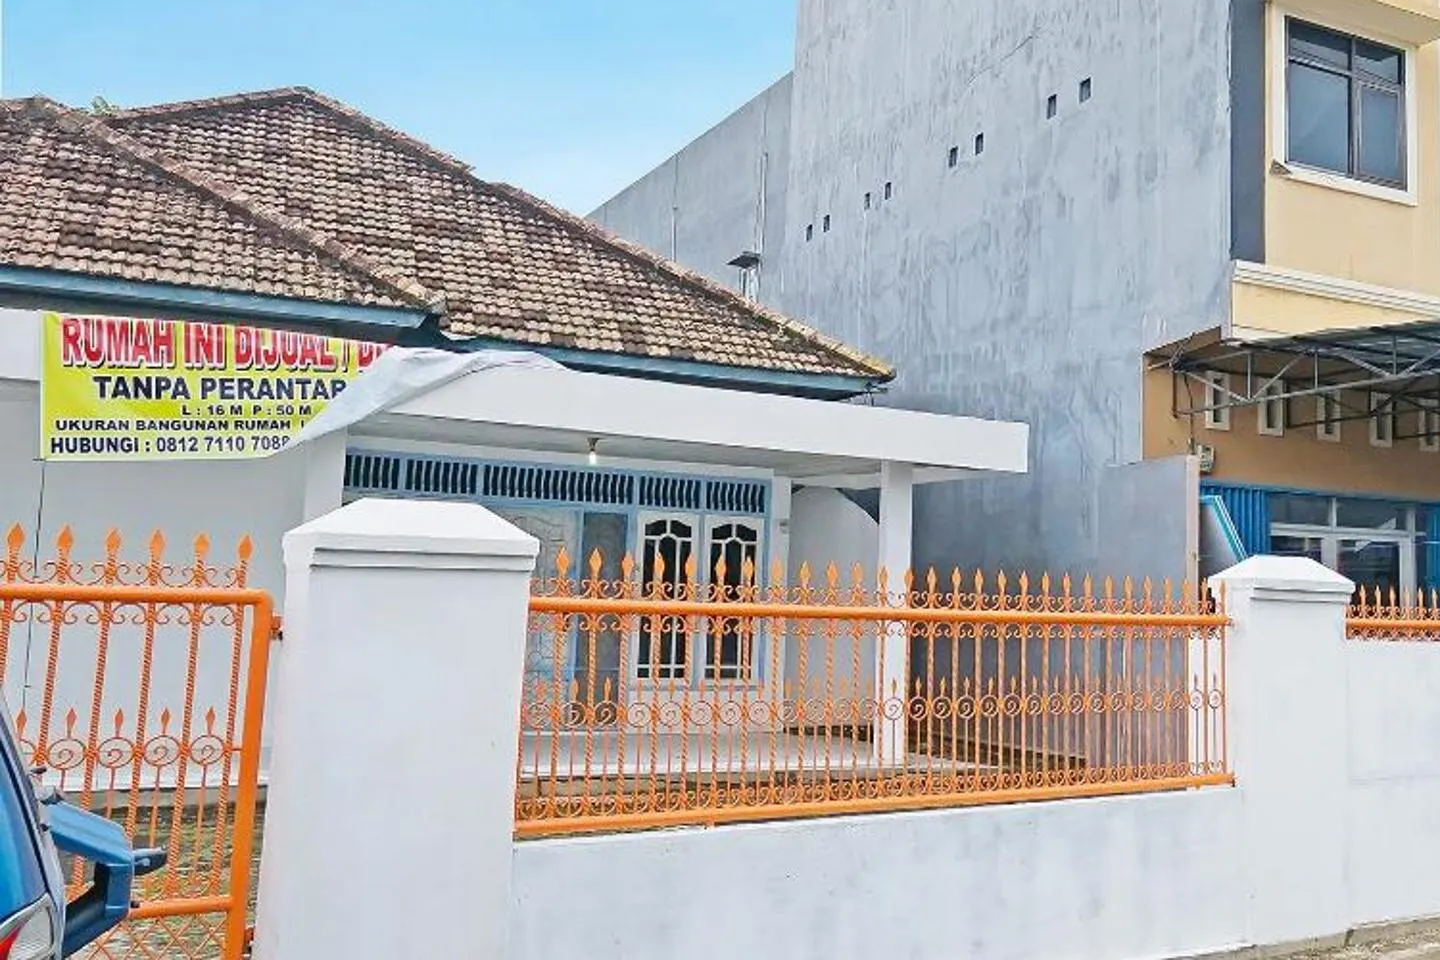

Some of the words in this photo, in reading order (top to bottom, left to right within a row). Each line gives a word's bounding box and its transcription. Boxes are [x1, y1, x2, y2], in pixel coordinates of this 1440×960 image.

[62, 317, 176, 369] RUMAH
[184, 321, 227, 371] INI
[234, 326, 337, 373] DIJUAL
[92, 376, 191, 400] TANPA
[182, 404, 192, 416] L
[207, 404, 226, 416] 16
[230, 405, 243, 416] M
[252, 405, 263, 416] P
[276, 405, 295, 416] 50
[299, 405, 312, 416] M
[55, 420, 130, 431] UKURAN
[135, 420, 229, 431] BANGUNAN
[234, 420, 291, 431] RUMAH
[50, 437, 139, 454] HUBUNGI
[156, 437, 199, 453] 0812
[204, 436, 246, 452] 7110
